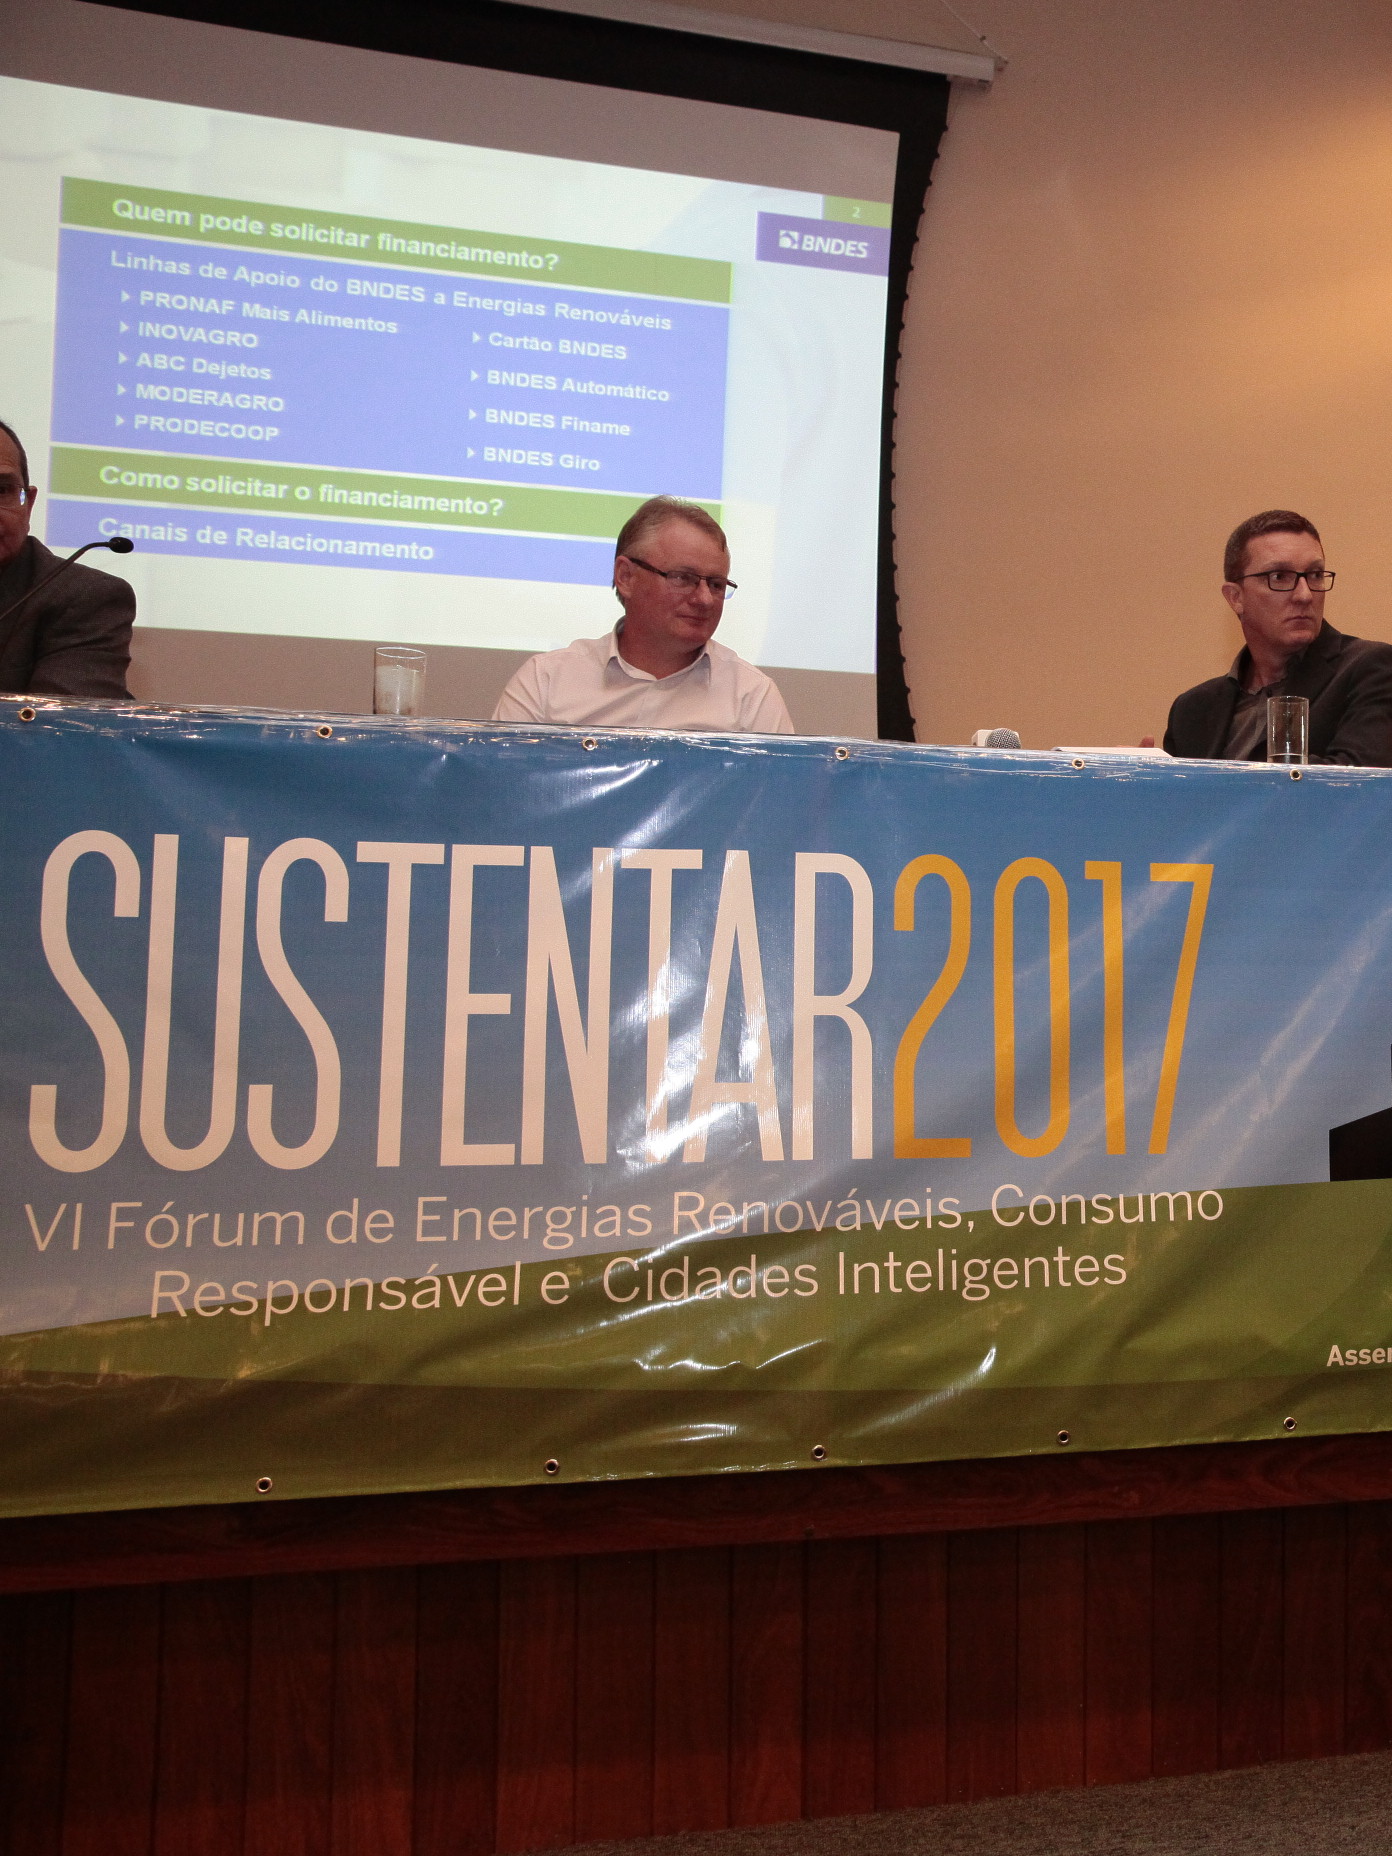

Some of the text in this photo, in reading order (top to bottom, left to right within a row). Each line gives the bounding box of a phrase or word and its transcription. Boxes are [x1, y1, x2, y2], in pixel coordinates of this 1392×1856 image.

[112, 198, 559, 271] Quem pode solicitar financiamento?
[801, 234, 868, 258] BNDES
[111, 250, 672, 331] Linhas de Apoio do BNDES a Energias Renováveis
[140, 290, 398, 334] PRONAF Mais Alimentos
[138, 320, 259, 348] INOVAGRO
[489, 331, 628, 360] Cartão BNDES
[136, 352, 272, 381] ABC Dejetos
[135, 383, 285, 412] MODERAGRO
[487, 369, 670, 402] BNDES Automático
[134, 414, 280, 442] PRODECOOP
[485, 408, 631, 437] BNDES Finame
[483, 446, 601, 471] BNDES Giro
[100, 466, 503, 518] Como solicitar o financiamento?
[98, 517, 435, 561] Canais de Relacionamento
[24, 1183, 1224, 1252] VI Fórum de Energias Renováveis, Consumo
[151, 1246, 1128, 1326] Responsável e Cidades Inteligentes
